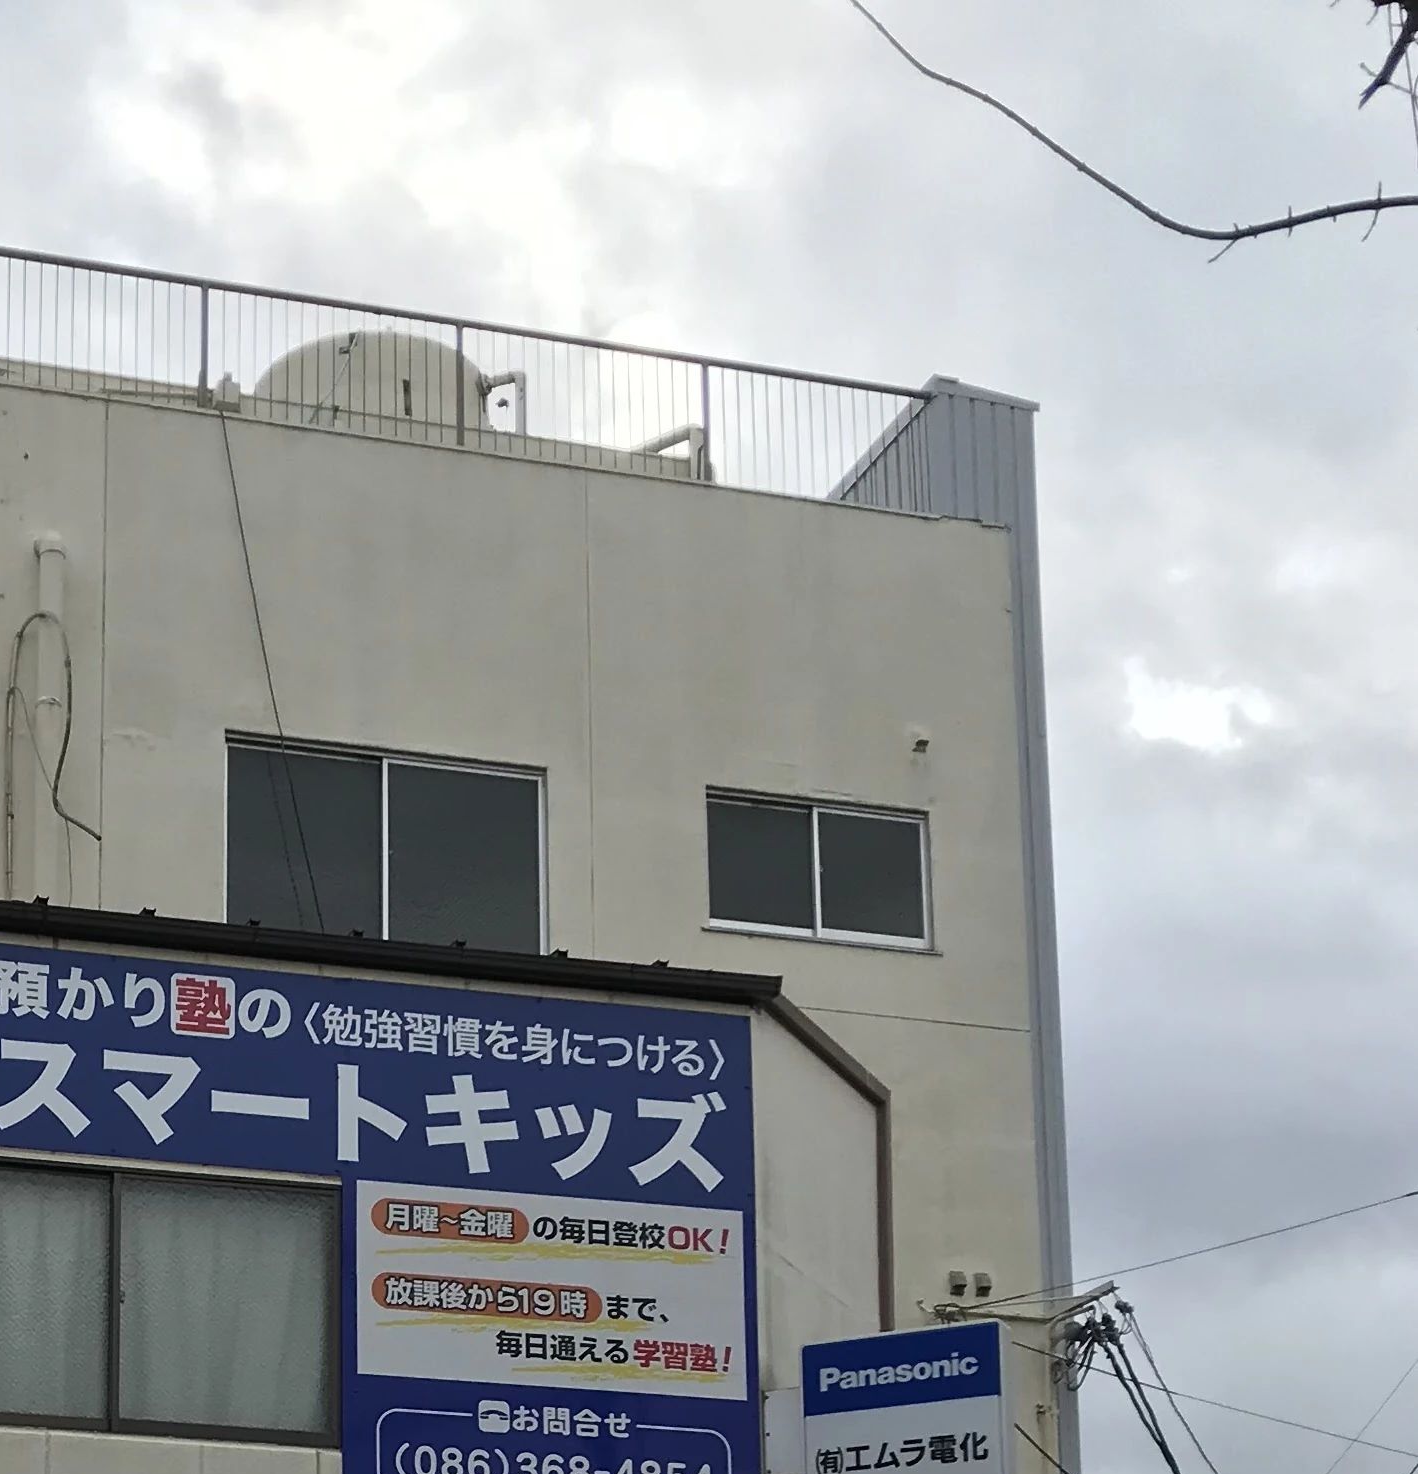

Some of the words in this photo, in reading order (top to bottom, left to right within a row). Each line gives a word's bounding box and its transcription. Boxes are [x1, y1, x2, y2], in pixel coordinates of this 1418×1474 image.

[819, 1352, 979, 1392] Panasonic
[512, 1405, 632, 1439] お問合せ
